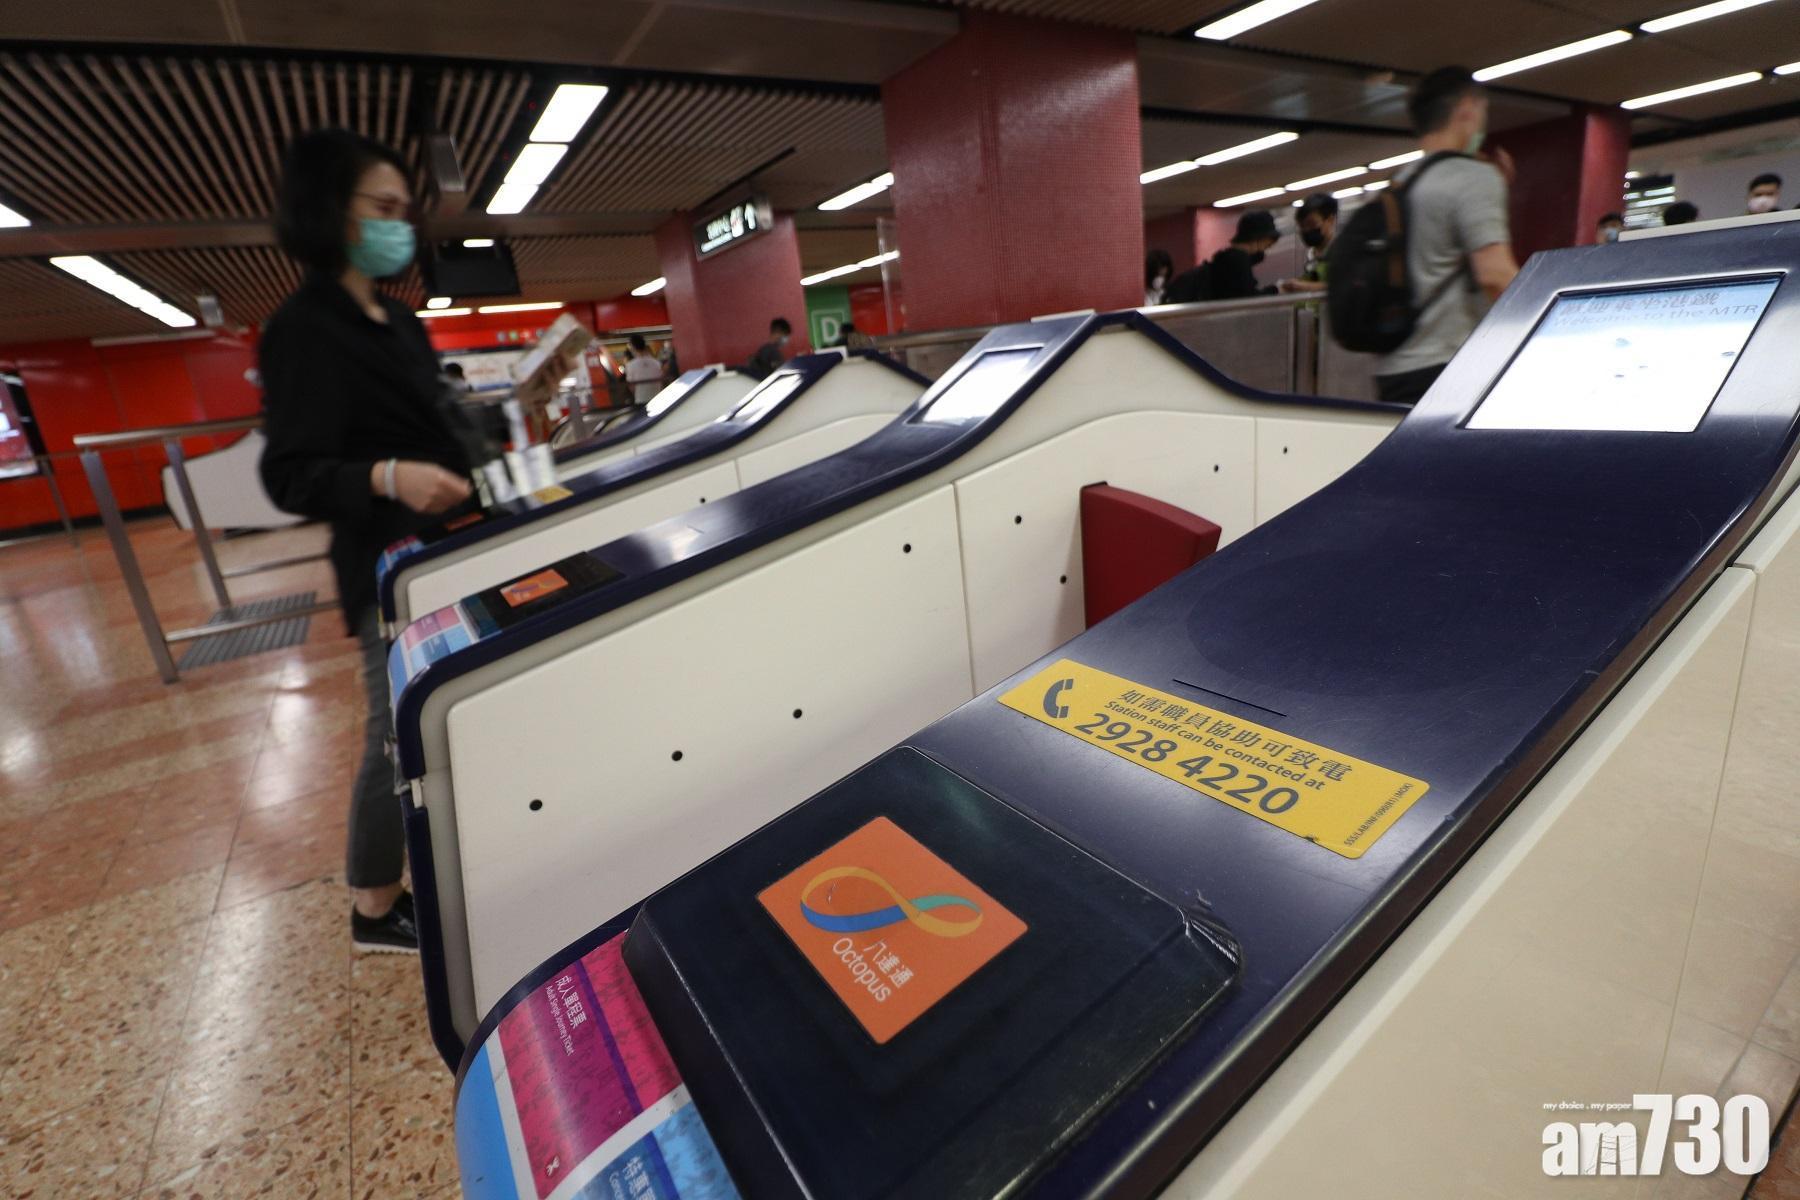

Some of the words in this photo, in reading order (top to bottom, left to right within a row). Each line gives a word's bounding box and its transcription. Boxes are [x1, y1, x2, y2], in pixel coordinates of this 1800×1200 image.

[820, 316, 839, 343] D
[1645, 310, 1664, 321] to
[1669, 308, 1702, 319] the
[1710, 303, 1759, 316] MTR
[1074, 712, 1178, 762] 2928
[1176, 754, 1300, 814] 4220
[1104, 700, 1147, 722] Station
[1147, 715, 1181, 734] staff
[1177, 728, 1202, 744] can
[1203, 736, 1224, 752] be
[1225, 747, 1304, 783] contacted
[1304, 776, 1326, 791] at
[1118, 688, 1353, 782] 如需職員協助可致電
[832, 937, 892, 1002] Octopus
[863, 939, 915, 989] 八達通
[550, 998, 562, 1018] Single
[556, 1014, 568, 1040] Journey
[563, 1034, 575, 1057] Ticket
[555, 975, 587, 1029] 成人單程票
